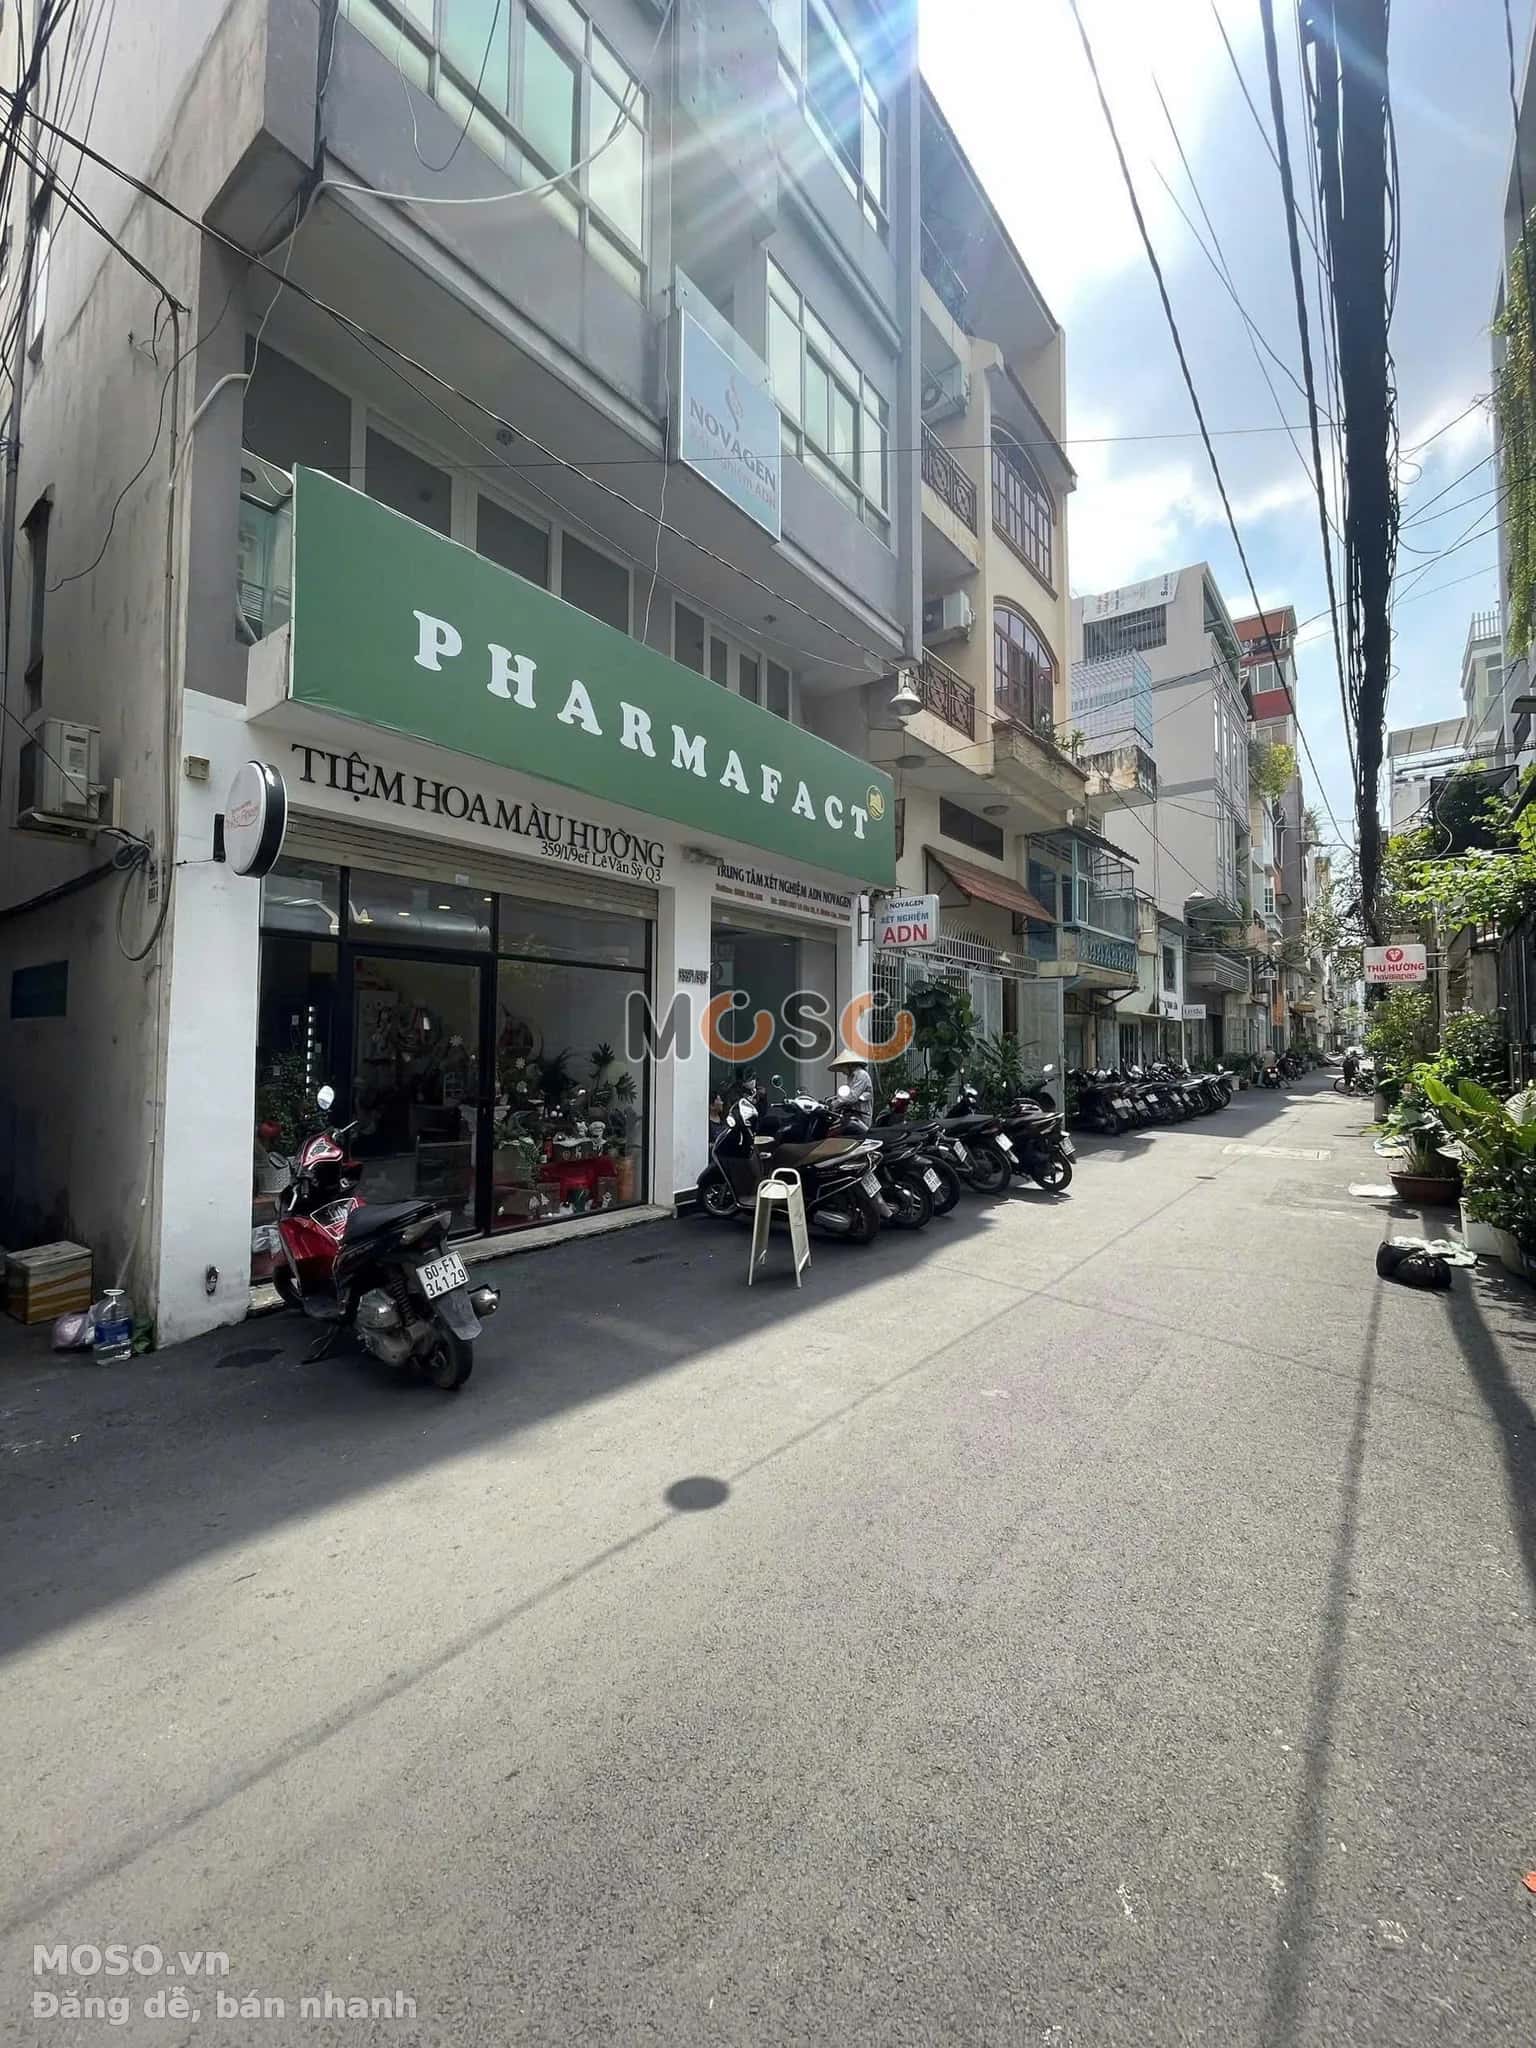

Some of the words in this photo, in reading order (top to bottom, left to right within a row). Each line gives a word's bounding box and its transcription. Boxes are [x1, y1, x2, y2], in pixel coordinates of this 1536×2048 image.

[690, 397, 775, 492] NOVAGEN
[413, 609, 868, 840] PHARMAFACT
[292, 743, 405, 804] TIỆM
[413, 776, 490, 825] HOA
[493, 799, 563, 842] MÀU
[568, 820, 665, 869] HƯỜNG
[540, 840, 590, 865] 359/1/9ef
[592, 852, 607, 869] Lê
[607, 855, 629, 874] Văn
[645, 867, 661, 884] Q3
[717, 864, 744, 882] TRUNG
[745, 868, 764, 887] TÂM
[764, 874, 778, 890] XÉT
[808, 888, 822, 902] ADN
[823, 892, 851, 909] NOVAGEN
[889, 899, 924, 909] NOVAGEN
[883, 923, 928, 944] ADN
[1367, 964, 1386, 972] THU
[424, 1257, 456, 1280] 60-F1
[426, 1268, 466, 1296] 341.29
